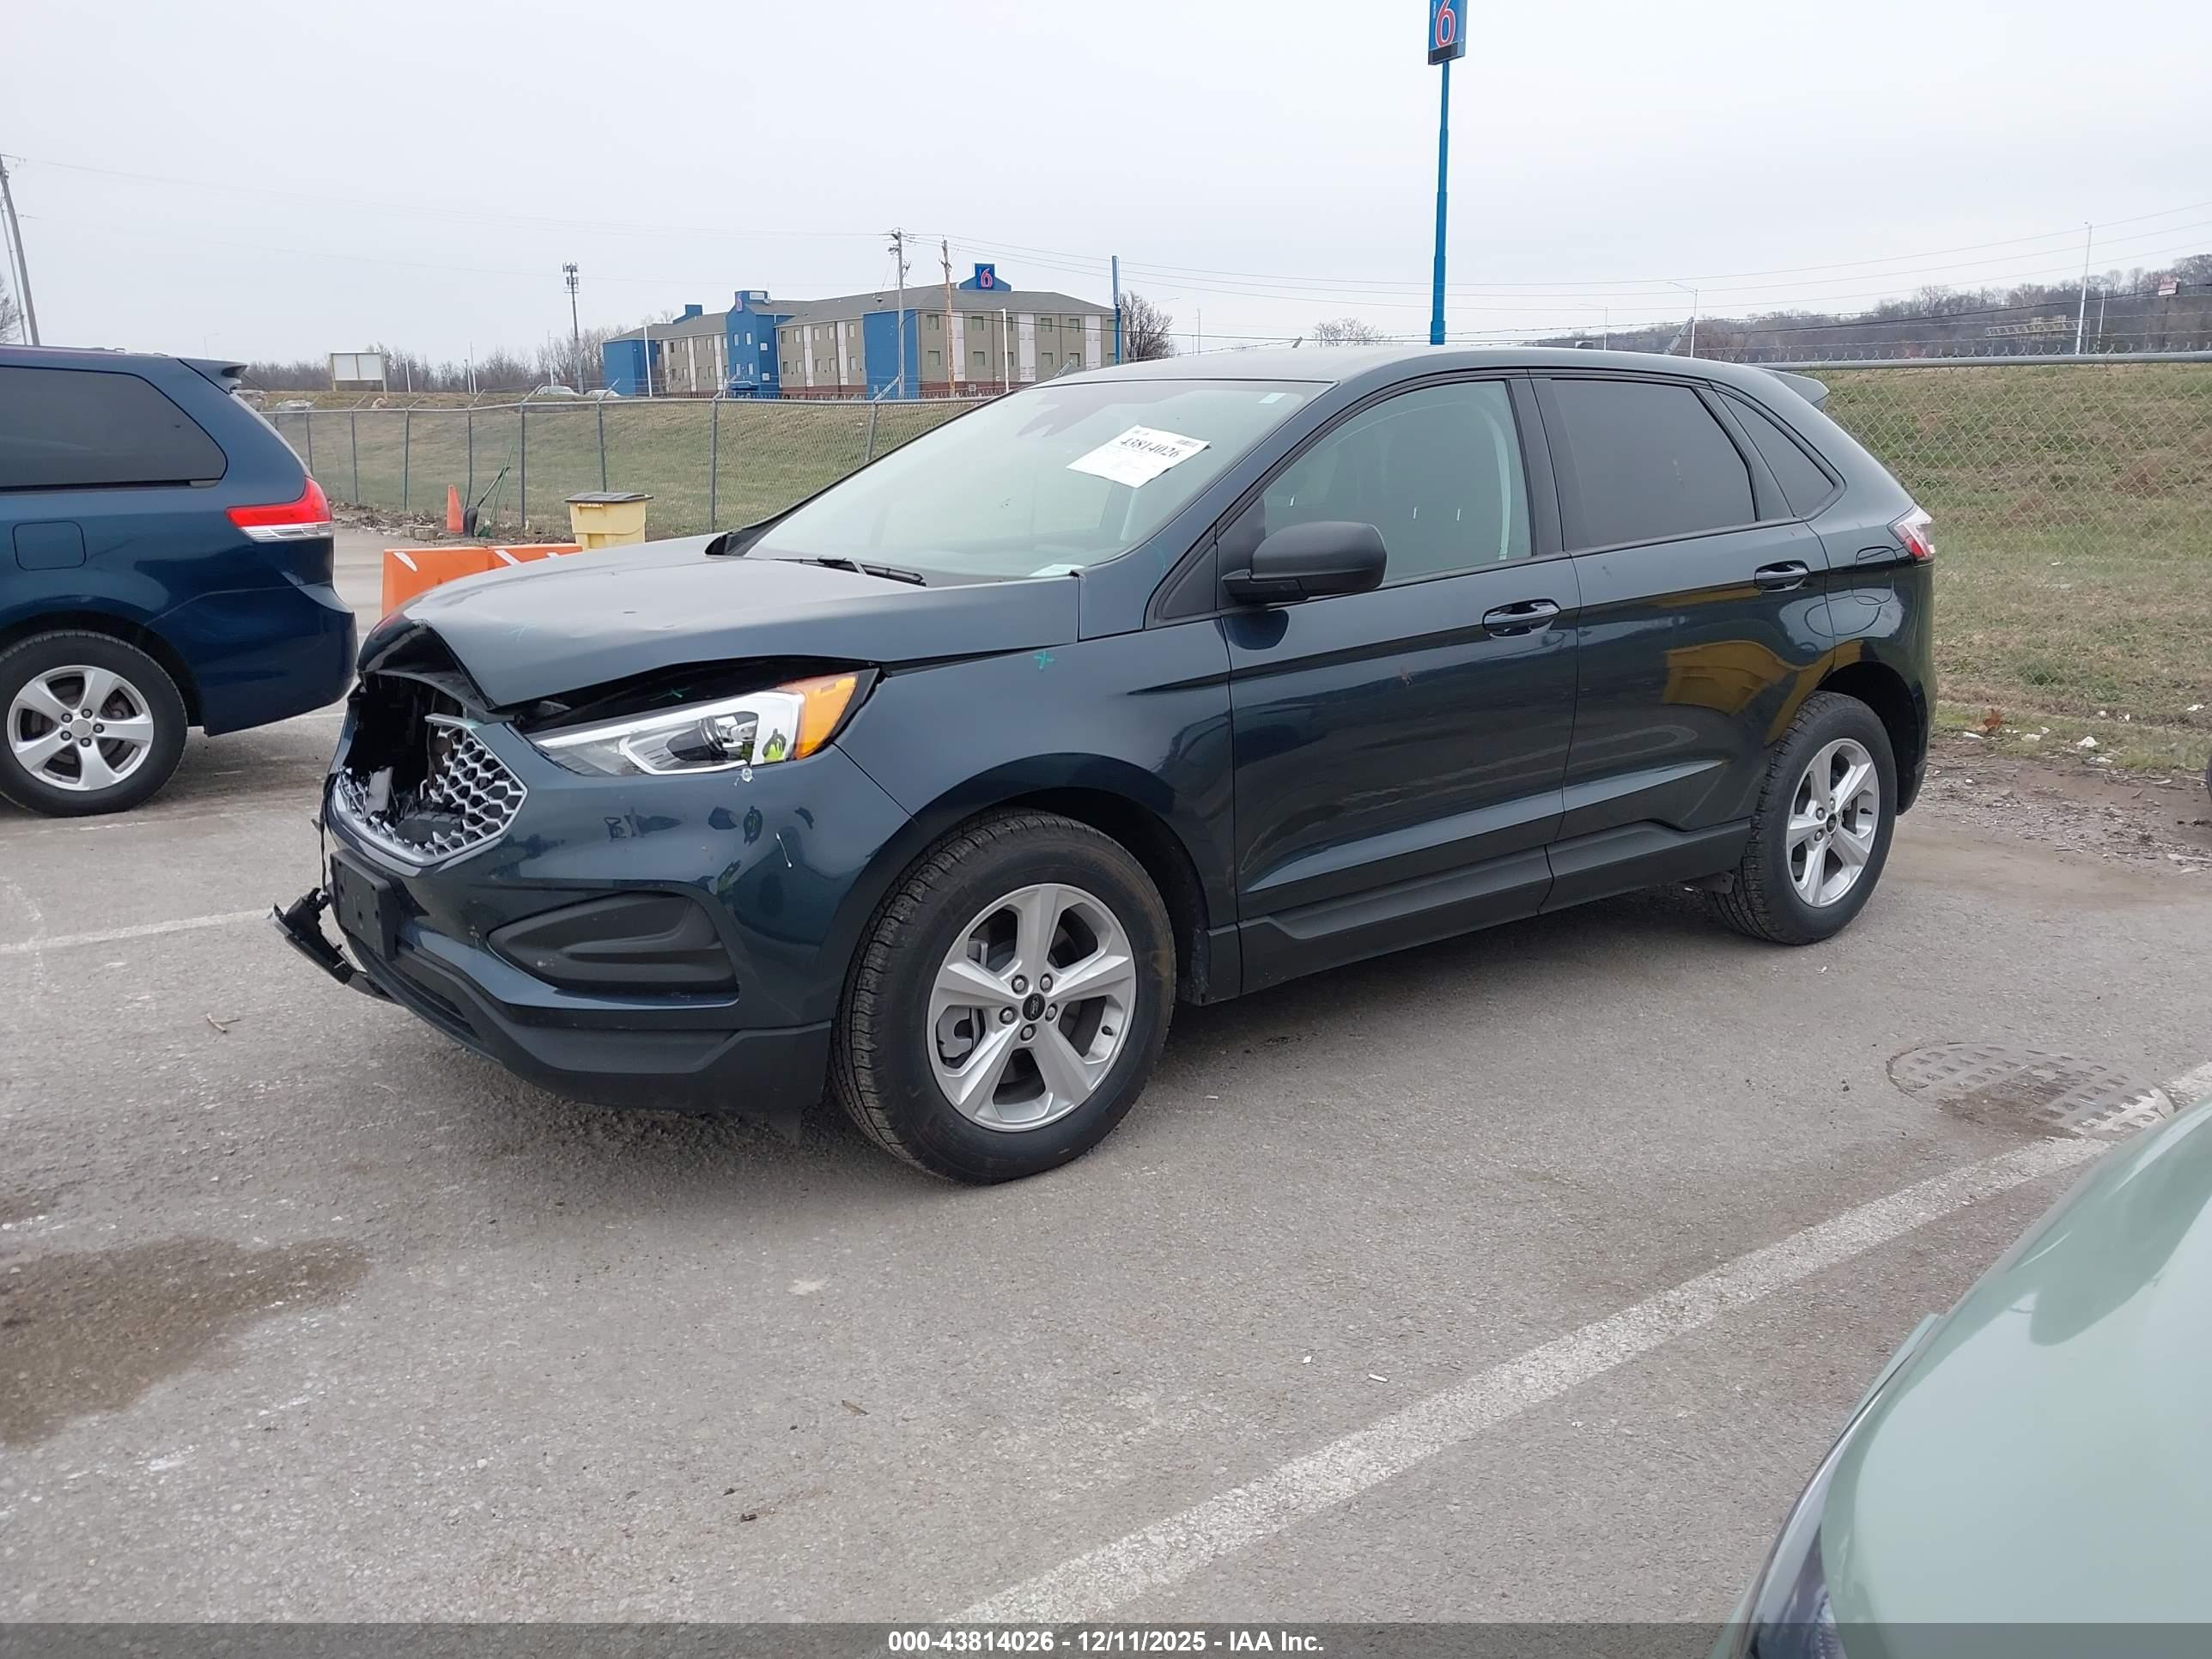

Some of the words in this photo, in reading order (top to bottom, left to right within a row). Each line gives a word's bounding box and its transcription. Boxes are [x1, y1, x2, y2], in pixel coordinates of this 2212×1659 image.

[1436, 0, 1456, 47] 6
[981, 267, 994, 289] 6
[1120, 437, 1181, 458] 43814026
